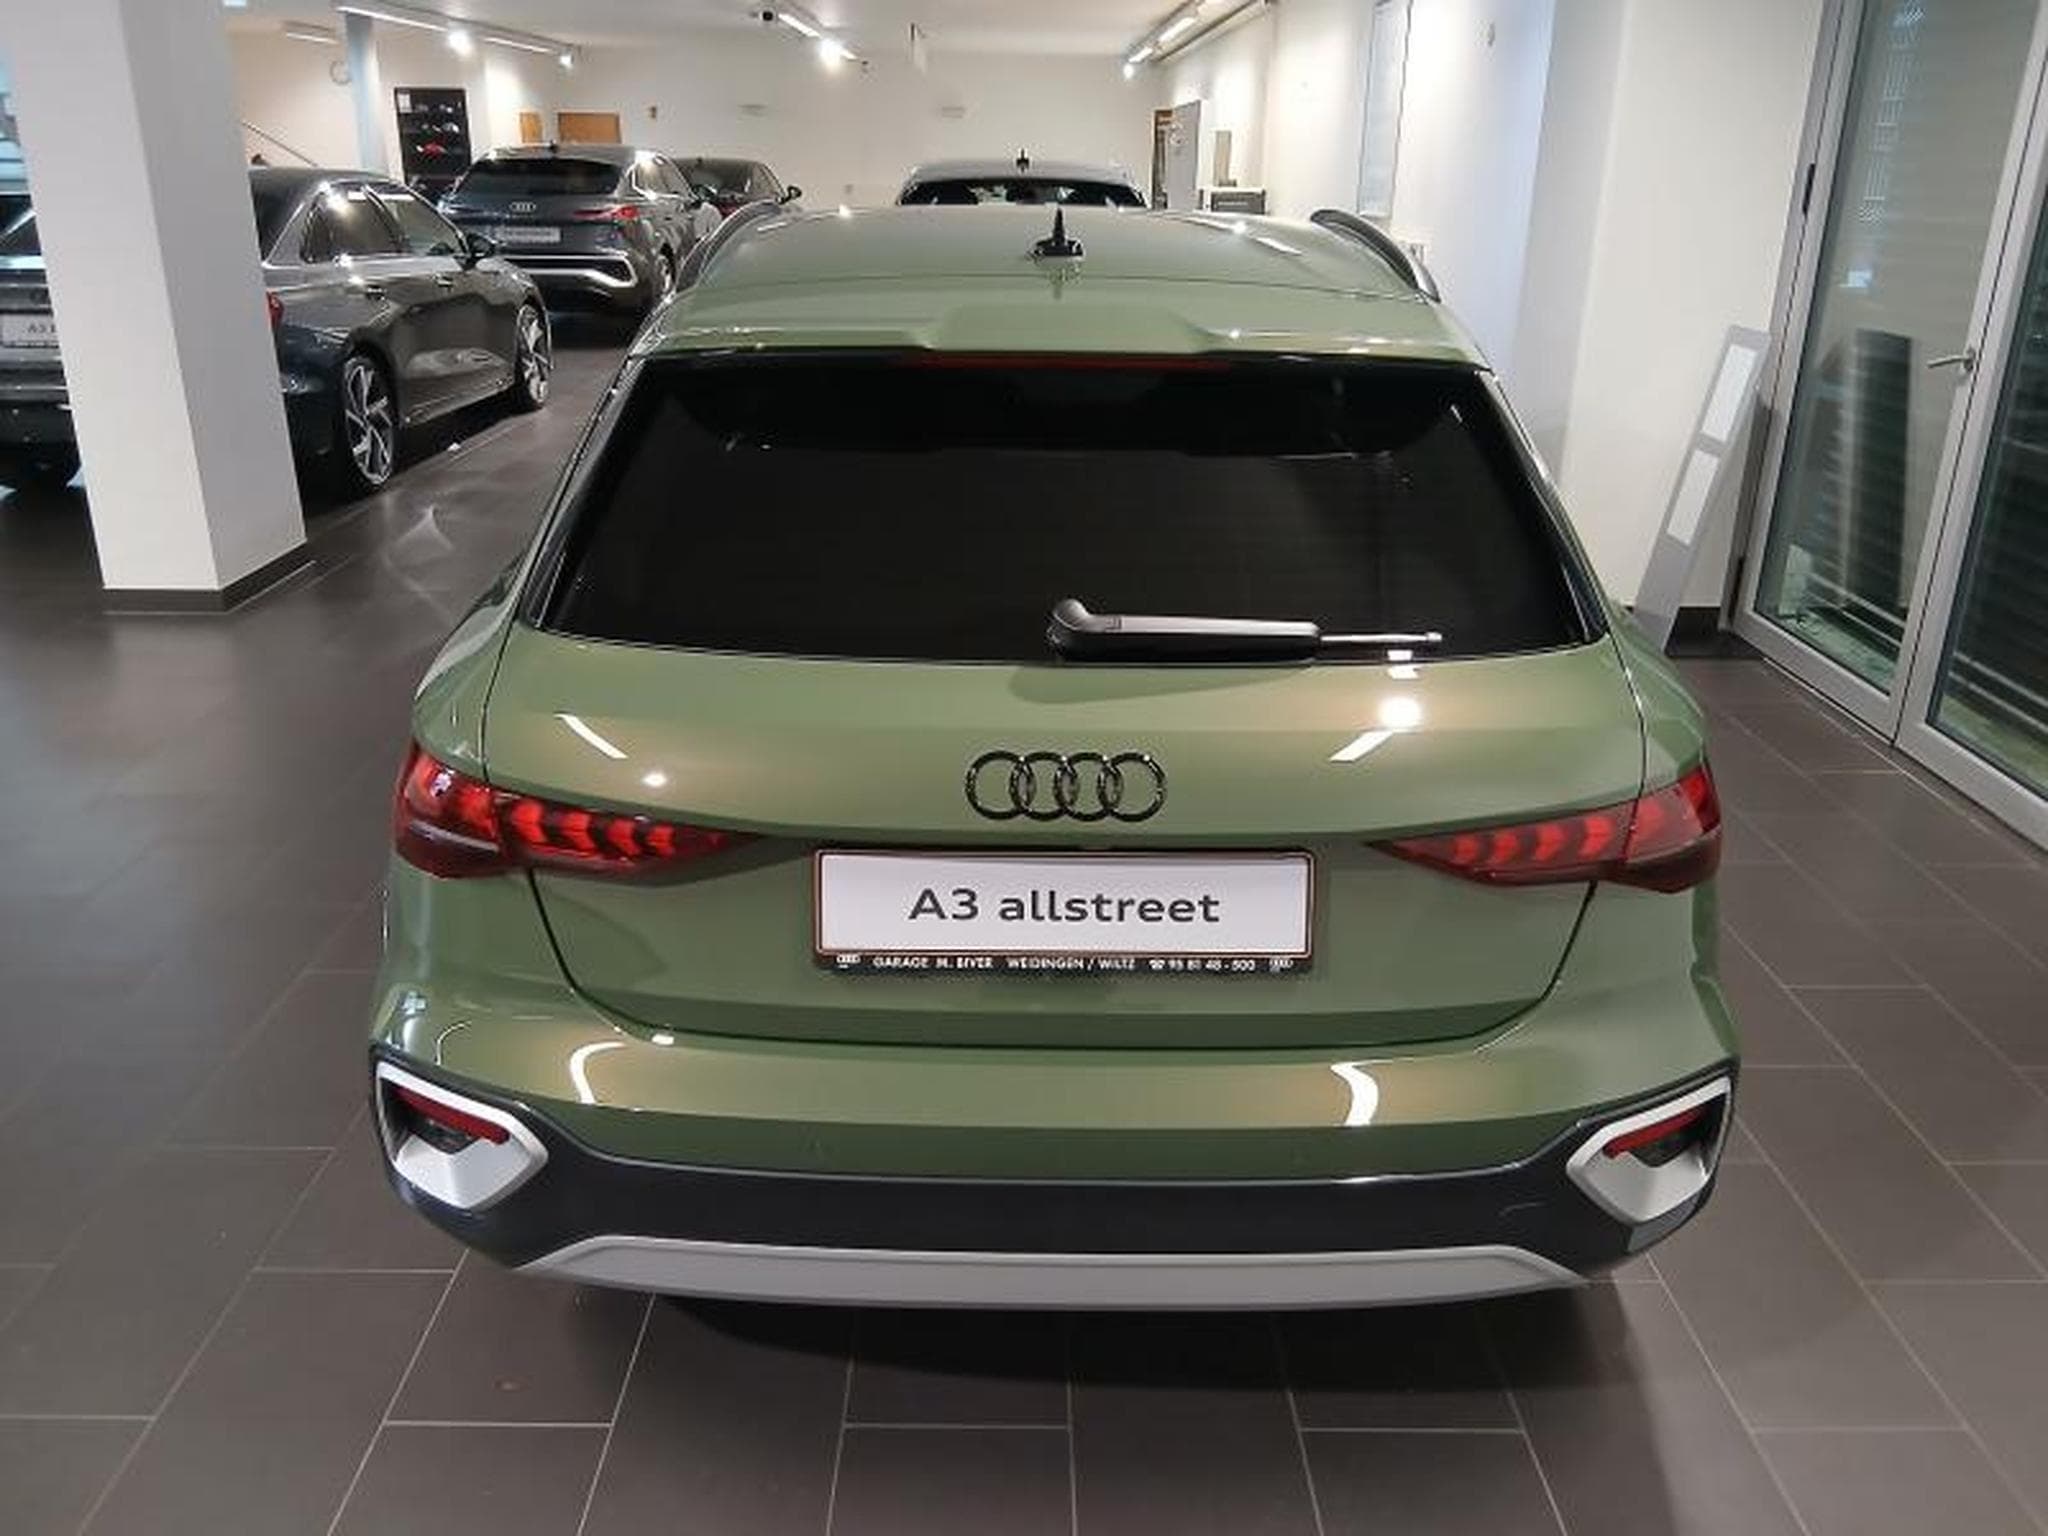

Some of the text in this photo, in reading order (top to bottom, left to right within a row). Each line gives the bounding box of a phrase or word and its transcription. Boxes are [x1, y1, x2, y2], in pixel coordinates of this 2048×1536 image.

[907, 887, 1221, 924] A3 allstreet
[872, 956, 929, 969] GARAGE
